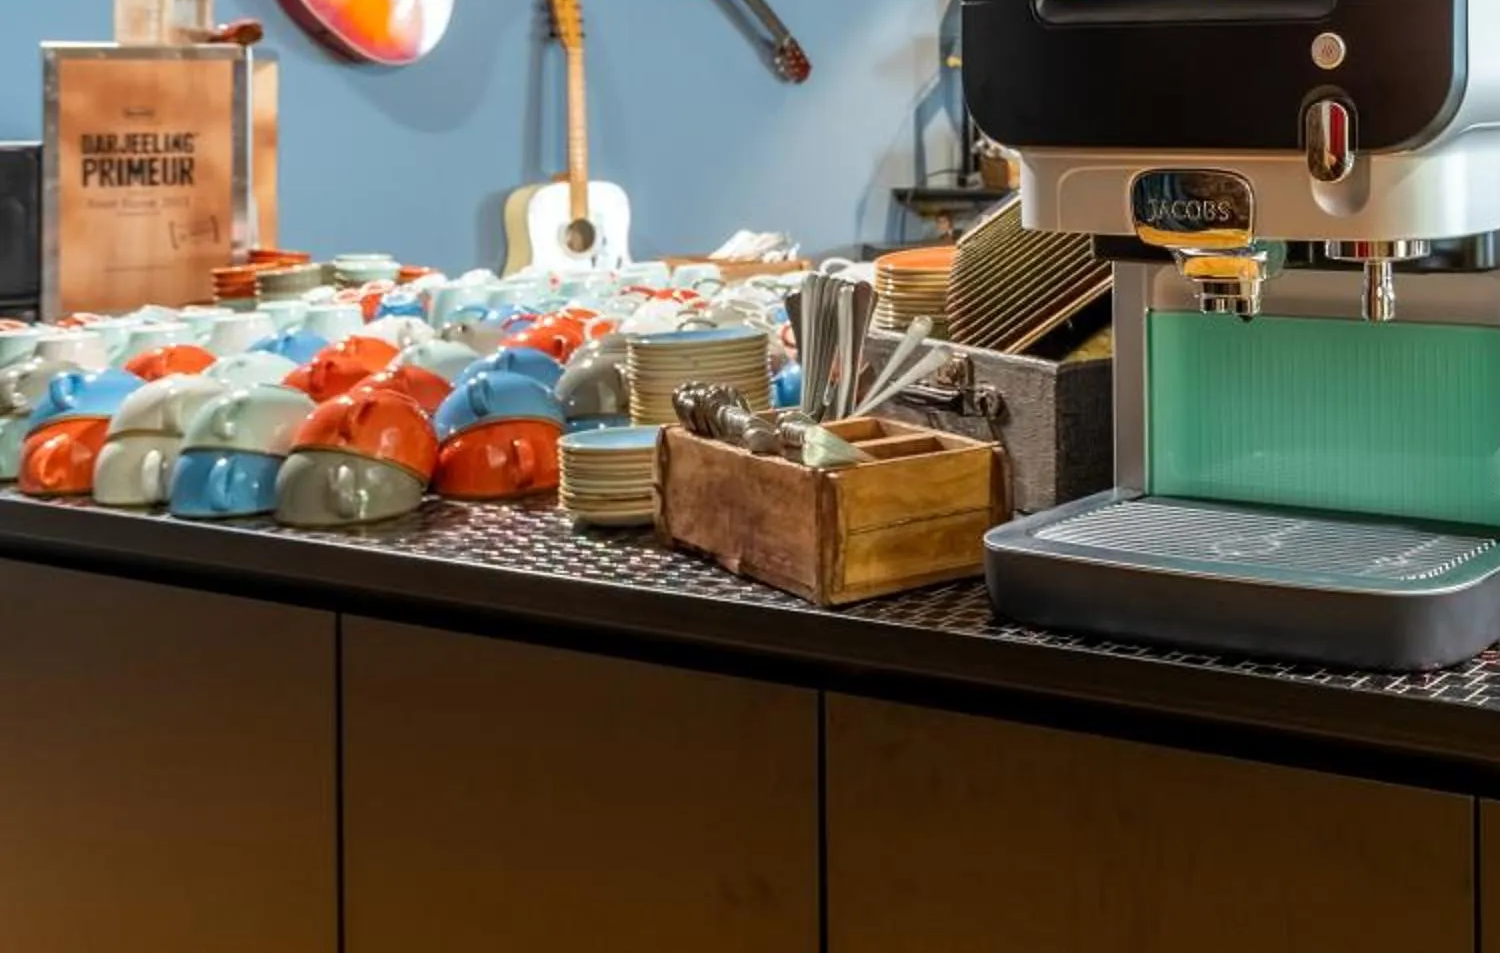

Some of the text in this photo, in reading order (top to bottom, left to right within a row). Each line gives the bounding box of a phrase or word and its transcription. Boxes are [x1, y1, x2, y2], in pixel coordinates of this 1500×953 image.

[80, 133, 195, 154] DARJEELING
[81, 157, 195, 187] PRIMEUR
[1147, 198, 1231, 222] JACOBS
